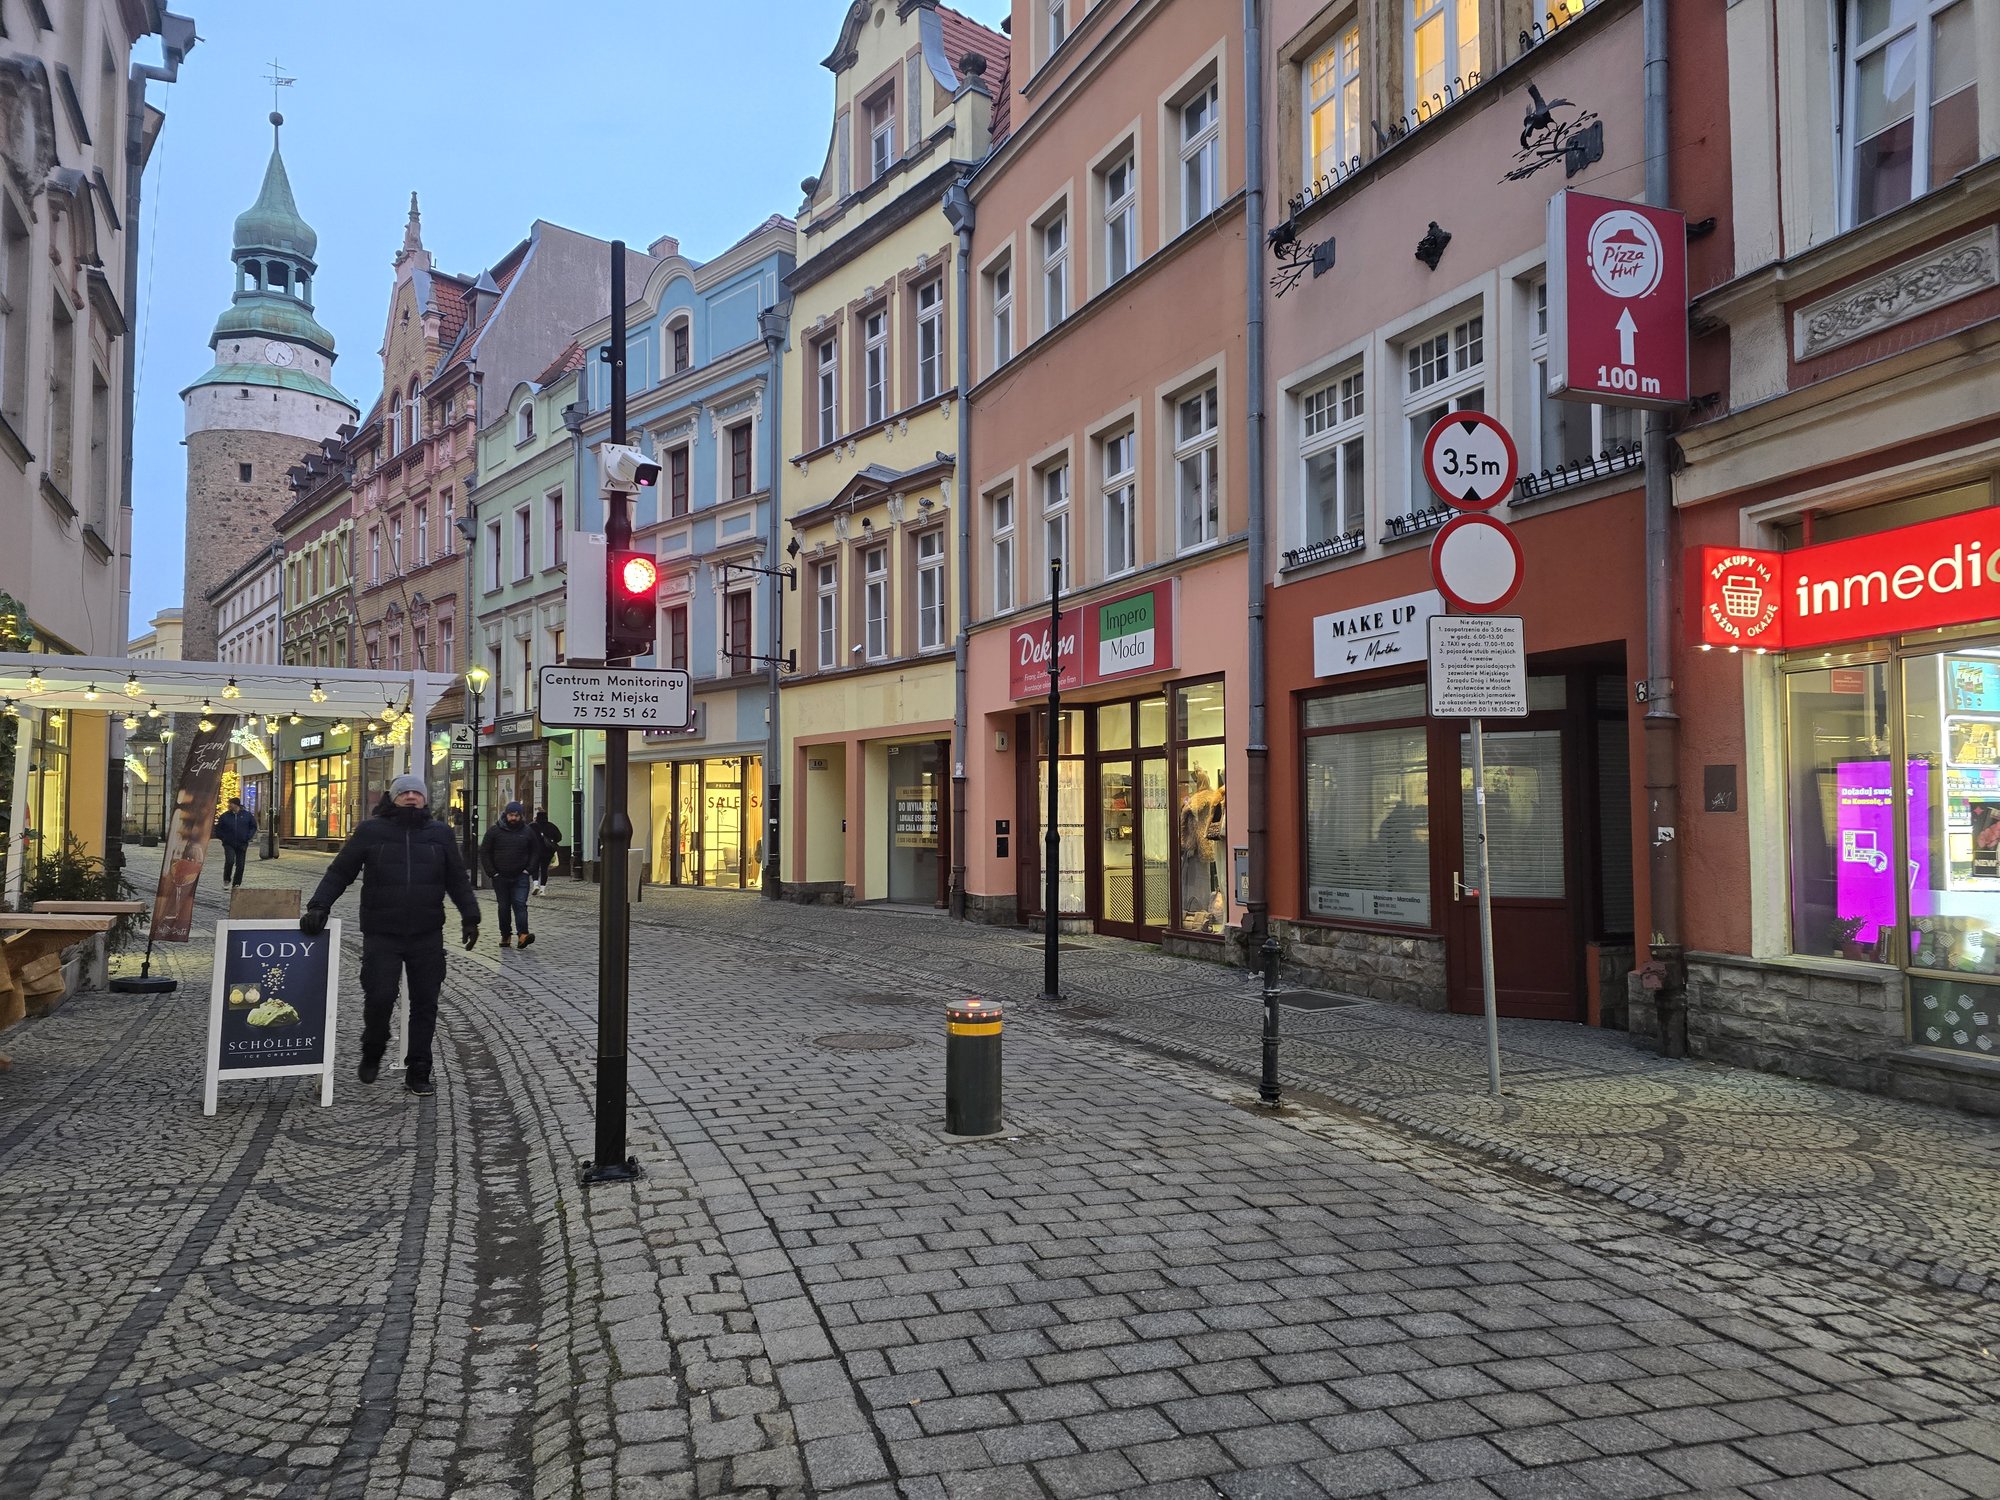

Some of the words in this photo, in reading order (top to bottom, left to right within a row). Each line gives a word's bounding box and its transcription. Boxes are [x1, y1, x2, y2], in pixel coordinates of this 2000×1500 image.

[1603, 245, 1644, 266] Pizza
[1610, 263, 1643, 280] Hut
[1598, 365, 1638, 390] 100
[1642, 376, 1660, 394] m
[1442, 448, 1500, 478] 3,5m
[1711, 556, 1756, 580] ZAKUPY
[1756, 563, 1772, 582] NA
[1106, 607, 1146, 636] Impero
[1332, 612, 1384, 638] MAKE
[1392, 605, 1416, 625] UP
[1016, 629, 1074, 666] Dekra
[1110, 636, 1145, 661] Moda
[1346, 650, 1358, 664] by
[1364, 640, 1401, 662] Martha
[546, 674, 600, 686] Centrum
[607, 676, 684, 690] Monitoringu
[1636, 682, 1646, 702] 6
[572, 690, 604, 702] Straż
[611, 692, 659, 705] Miejska
[573, 706, 588, 717] 75
[594, 707, 616, 718] 752
[623, 708, 635, 718] 51
[641, 708, 657, 719] 62
[708, 796, 740, 808] SALE
[898, 802, 905, 812] DO
[240, 940, 315, 958] LODY
